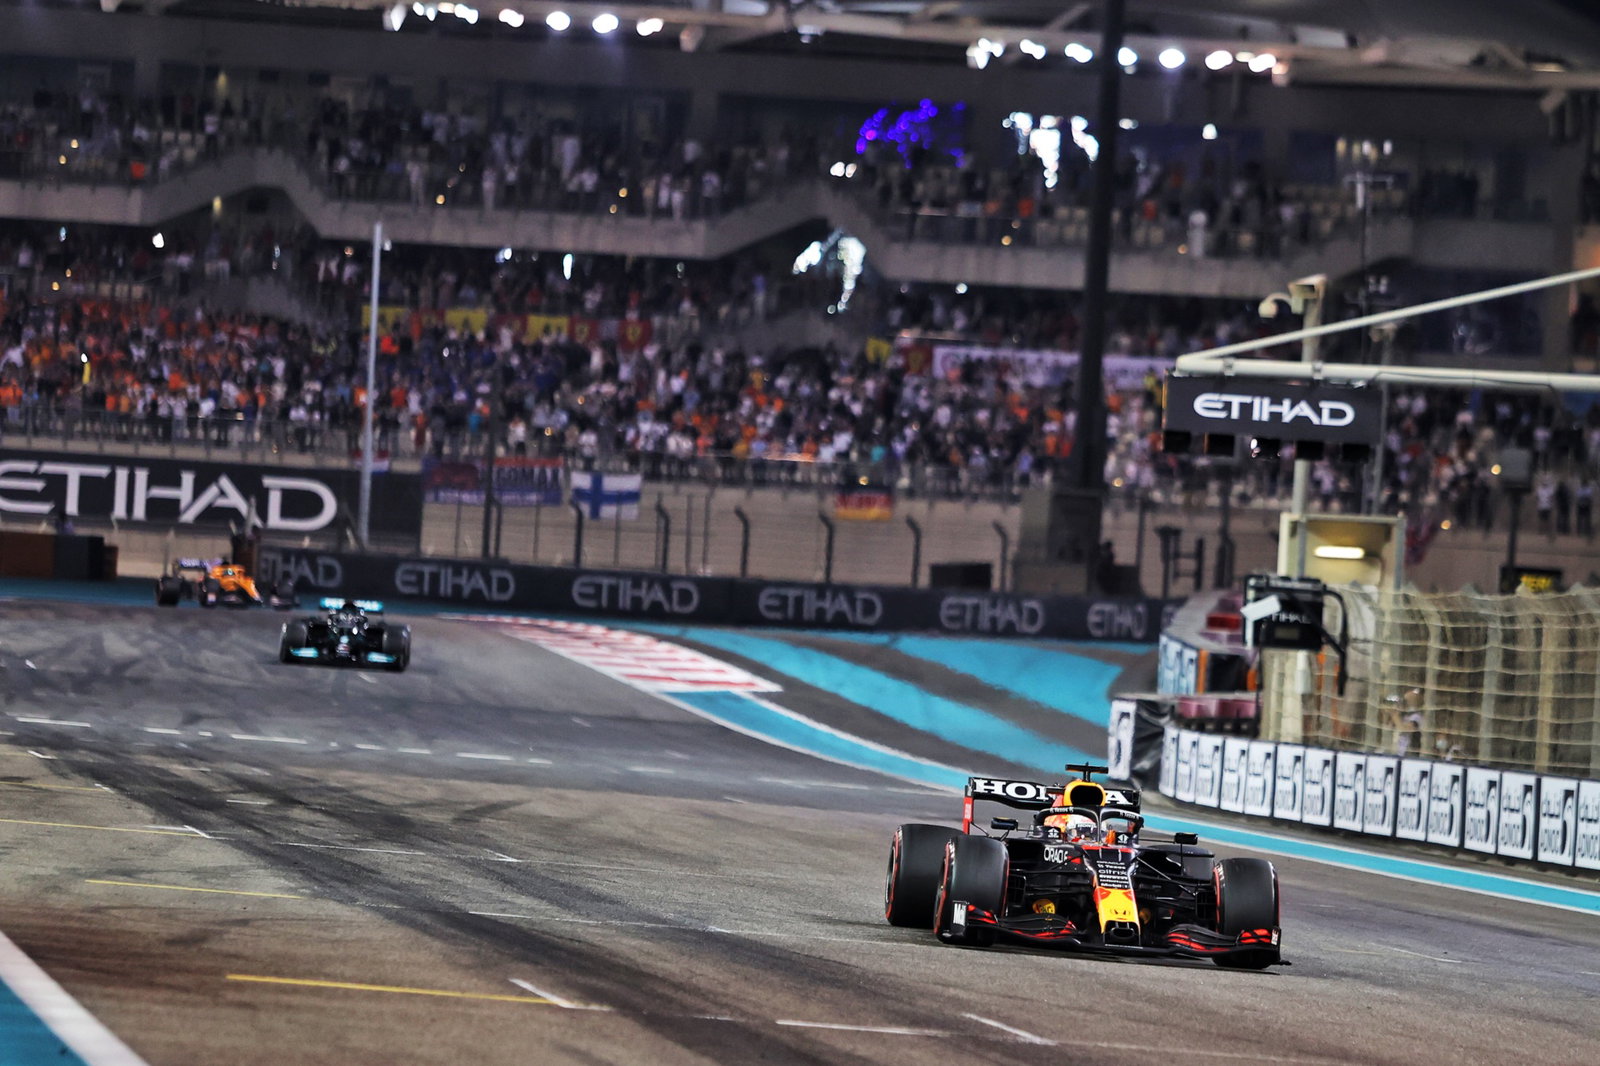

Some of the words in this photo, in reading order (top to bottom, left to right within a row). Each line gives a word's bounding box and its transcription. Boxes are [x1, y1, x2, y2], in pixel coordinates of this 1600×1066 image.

[1193, 392, 1356, 427] ETIHAD
[0, 460, 338, 532] ETIHAD
[395, 562, 516, 601] ETIHAD
[571, 575, 699, 614] ETIHAD
[757, 586, 883, 626] ETIHAD
[939, 595, 1046, 634] ETIHAD
